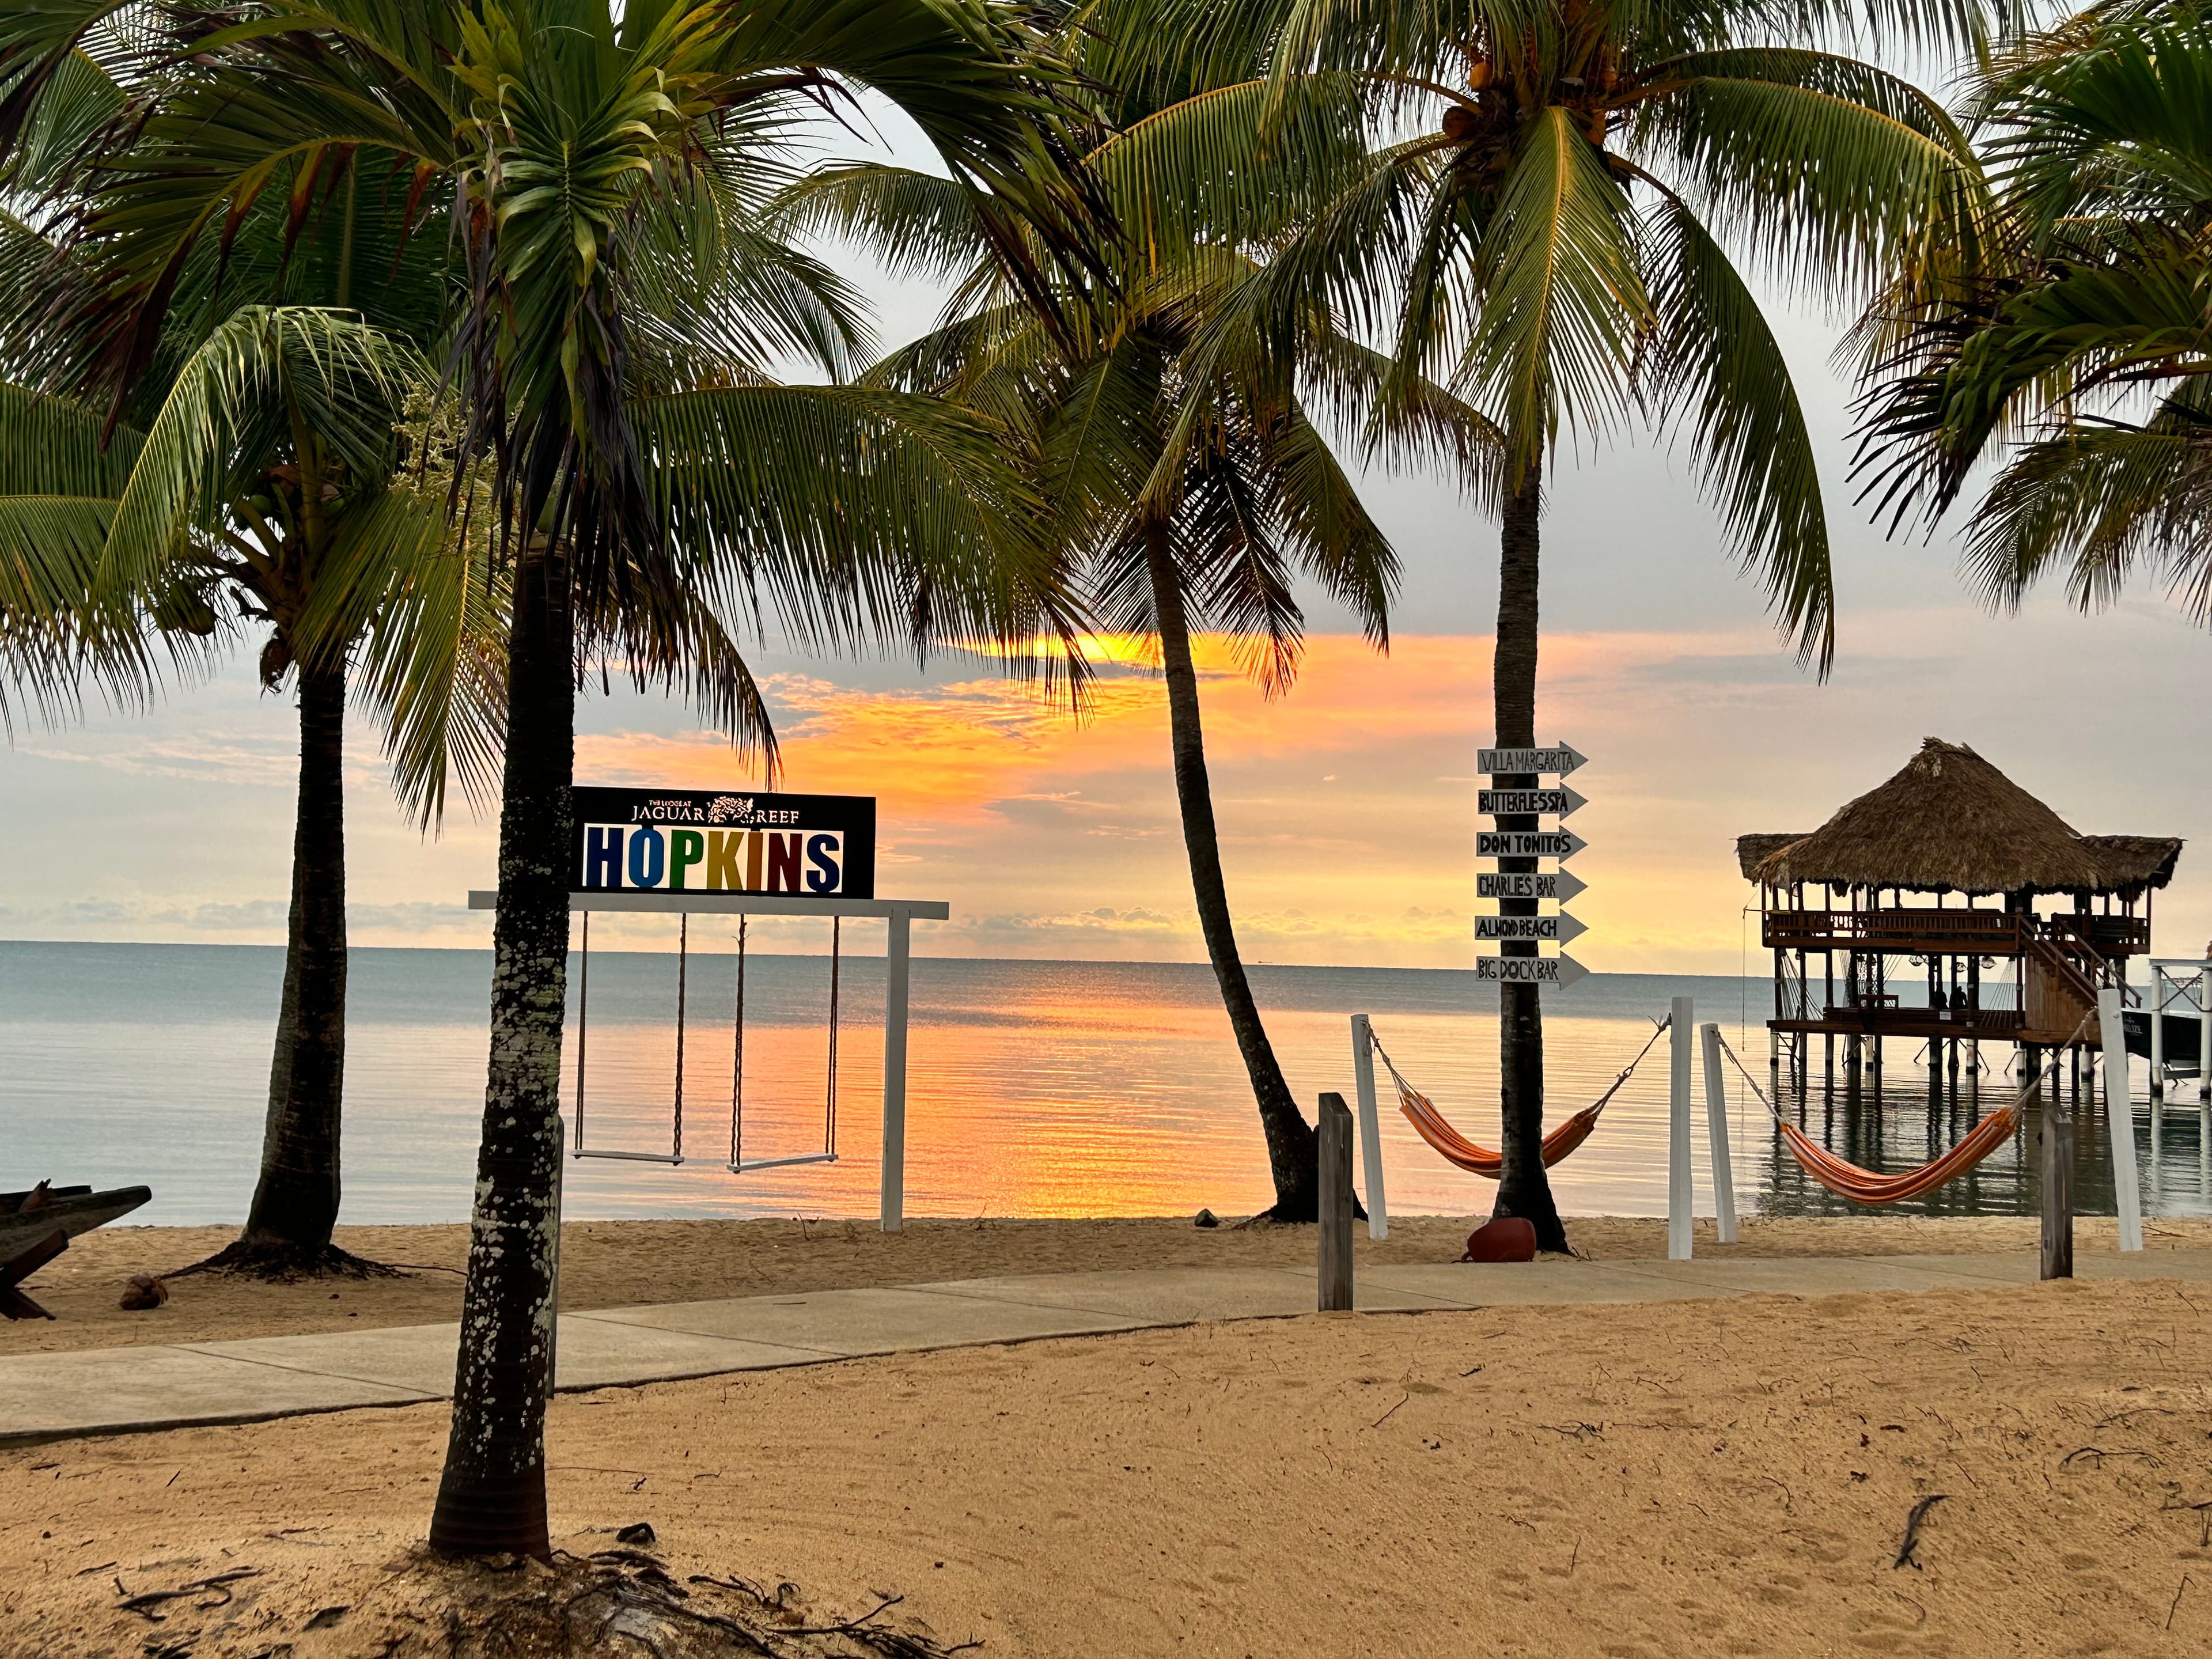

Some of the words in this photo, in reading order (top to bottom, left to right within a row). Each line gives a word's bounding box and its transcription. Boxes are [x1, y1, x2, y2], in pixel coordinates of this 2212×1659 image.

[1481, 752, 1513, 771] VILLA
[1516, 751, 1574, 772] MARGARITA
[1547, 792, 1568, 812] SPA
[631, 805, 704, 821] JAGUAR
[756, 809, 799, 824] REEF
[1480, 835, 1510, 853] DON
[1514, 835, 1571, 853] TONITOS
[582, 824, 843, 893] HOPKINS
[1536, 876, 1556, 896] BAR
[1519, 918, 1556, 937] BEACH
[1478, 959, 1497, 979] BIG
[1500, 959, 1536, 980] DOCK
[1537, 961, 1559, 980] BAR
